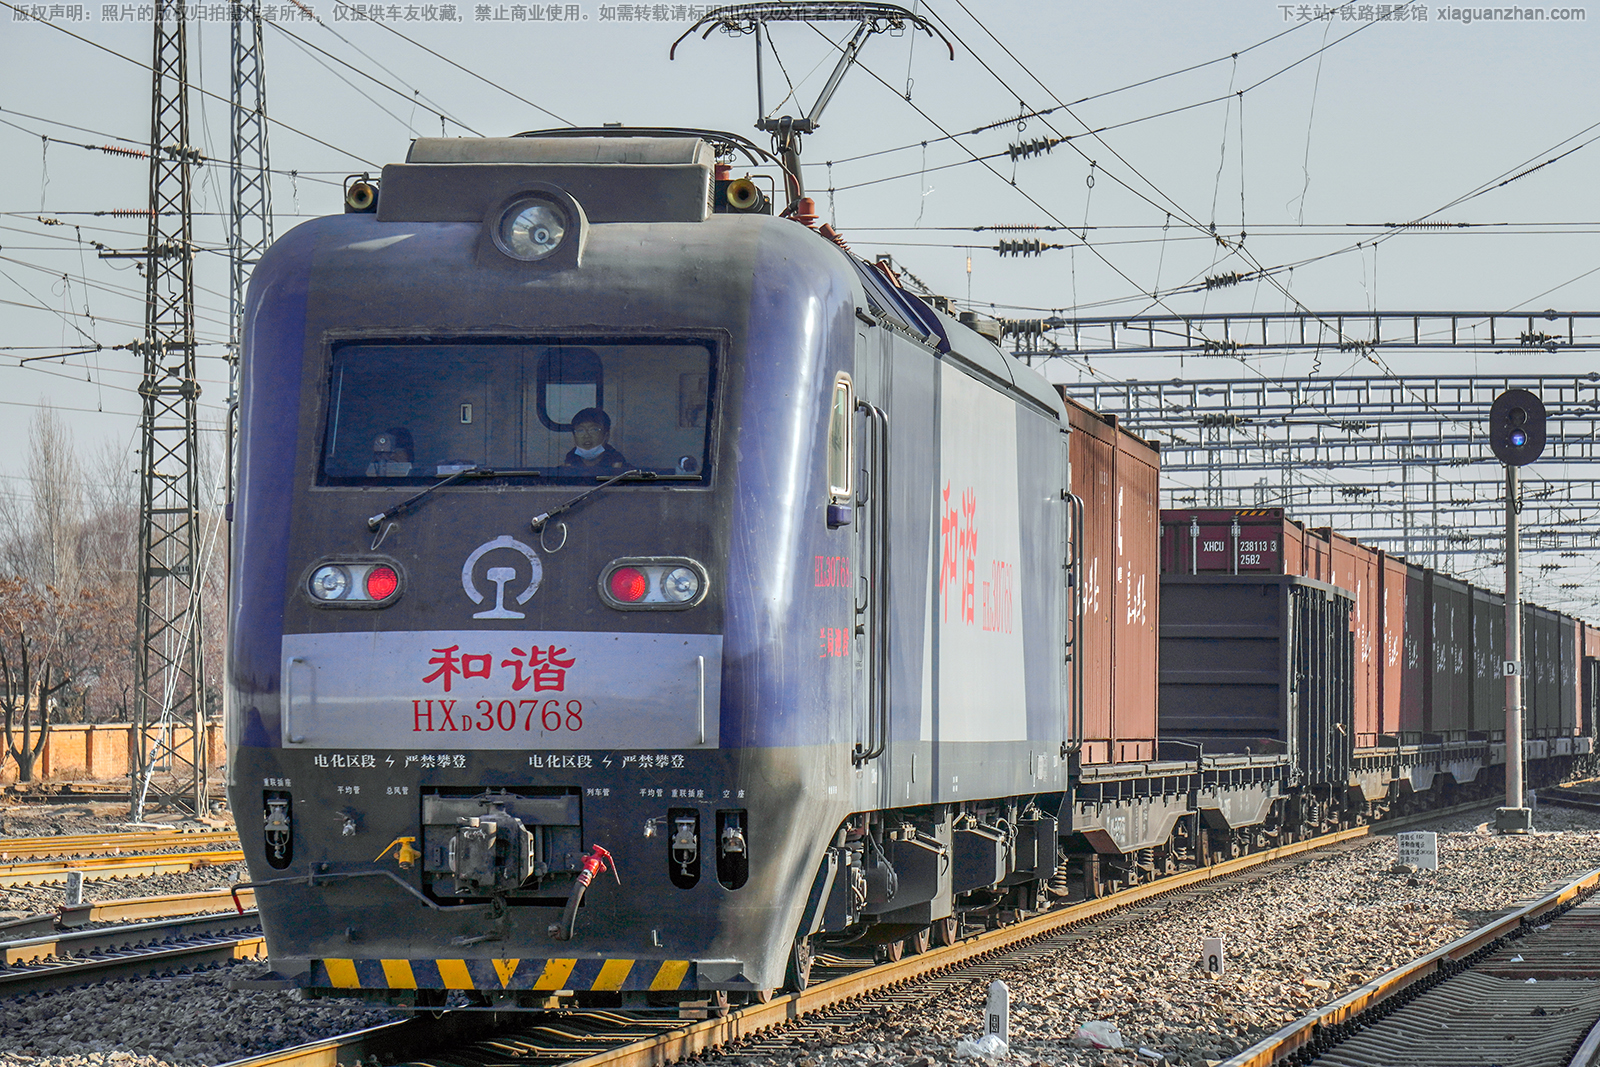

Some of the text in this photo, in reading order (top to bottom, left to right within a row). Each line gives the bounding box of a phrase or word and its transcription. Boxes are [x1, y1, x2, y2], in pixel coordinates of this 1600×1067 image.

[938, 479, 978, 626] 和谐
[1203, 541, 1225, 552] XHCU
[1240, 541, 1268, 552] 238113
[1240, 554, 1260, 565] 25B2
[422, 644, 576, 693] 和谐
[412, 699, 584, 732] HXD30768
[314, 754, 467, 769] 电化区段 严禁攀登
[529, 754, 685, 769] 电化区段 严禁攀登
[337, 786, 361, 795] 平均管
[386, 786, 409, 796] 总风管
[586, 788, 610, 797] 列车管
[639, 788, 664, 798] 平均管
[1208, 954, 1218, 972] 8
